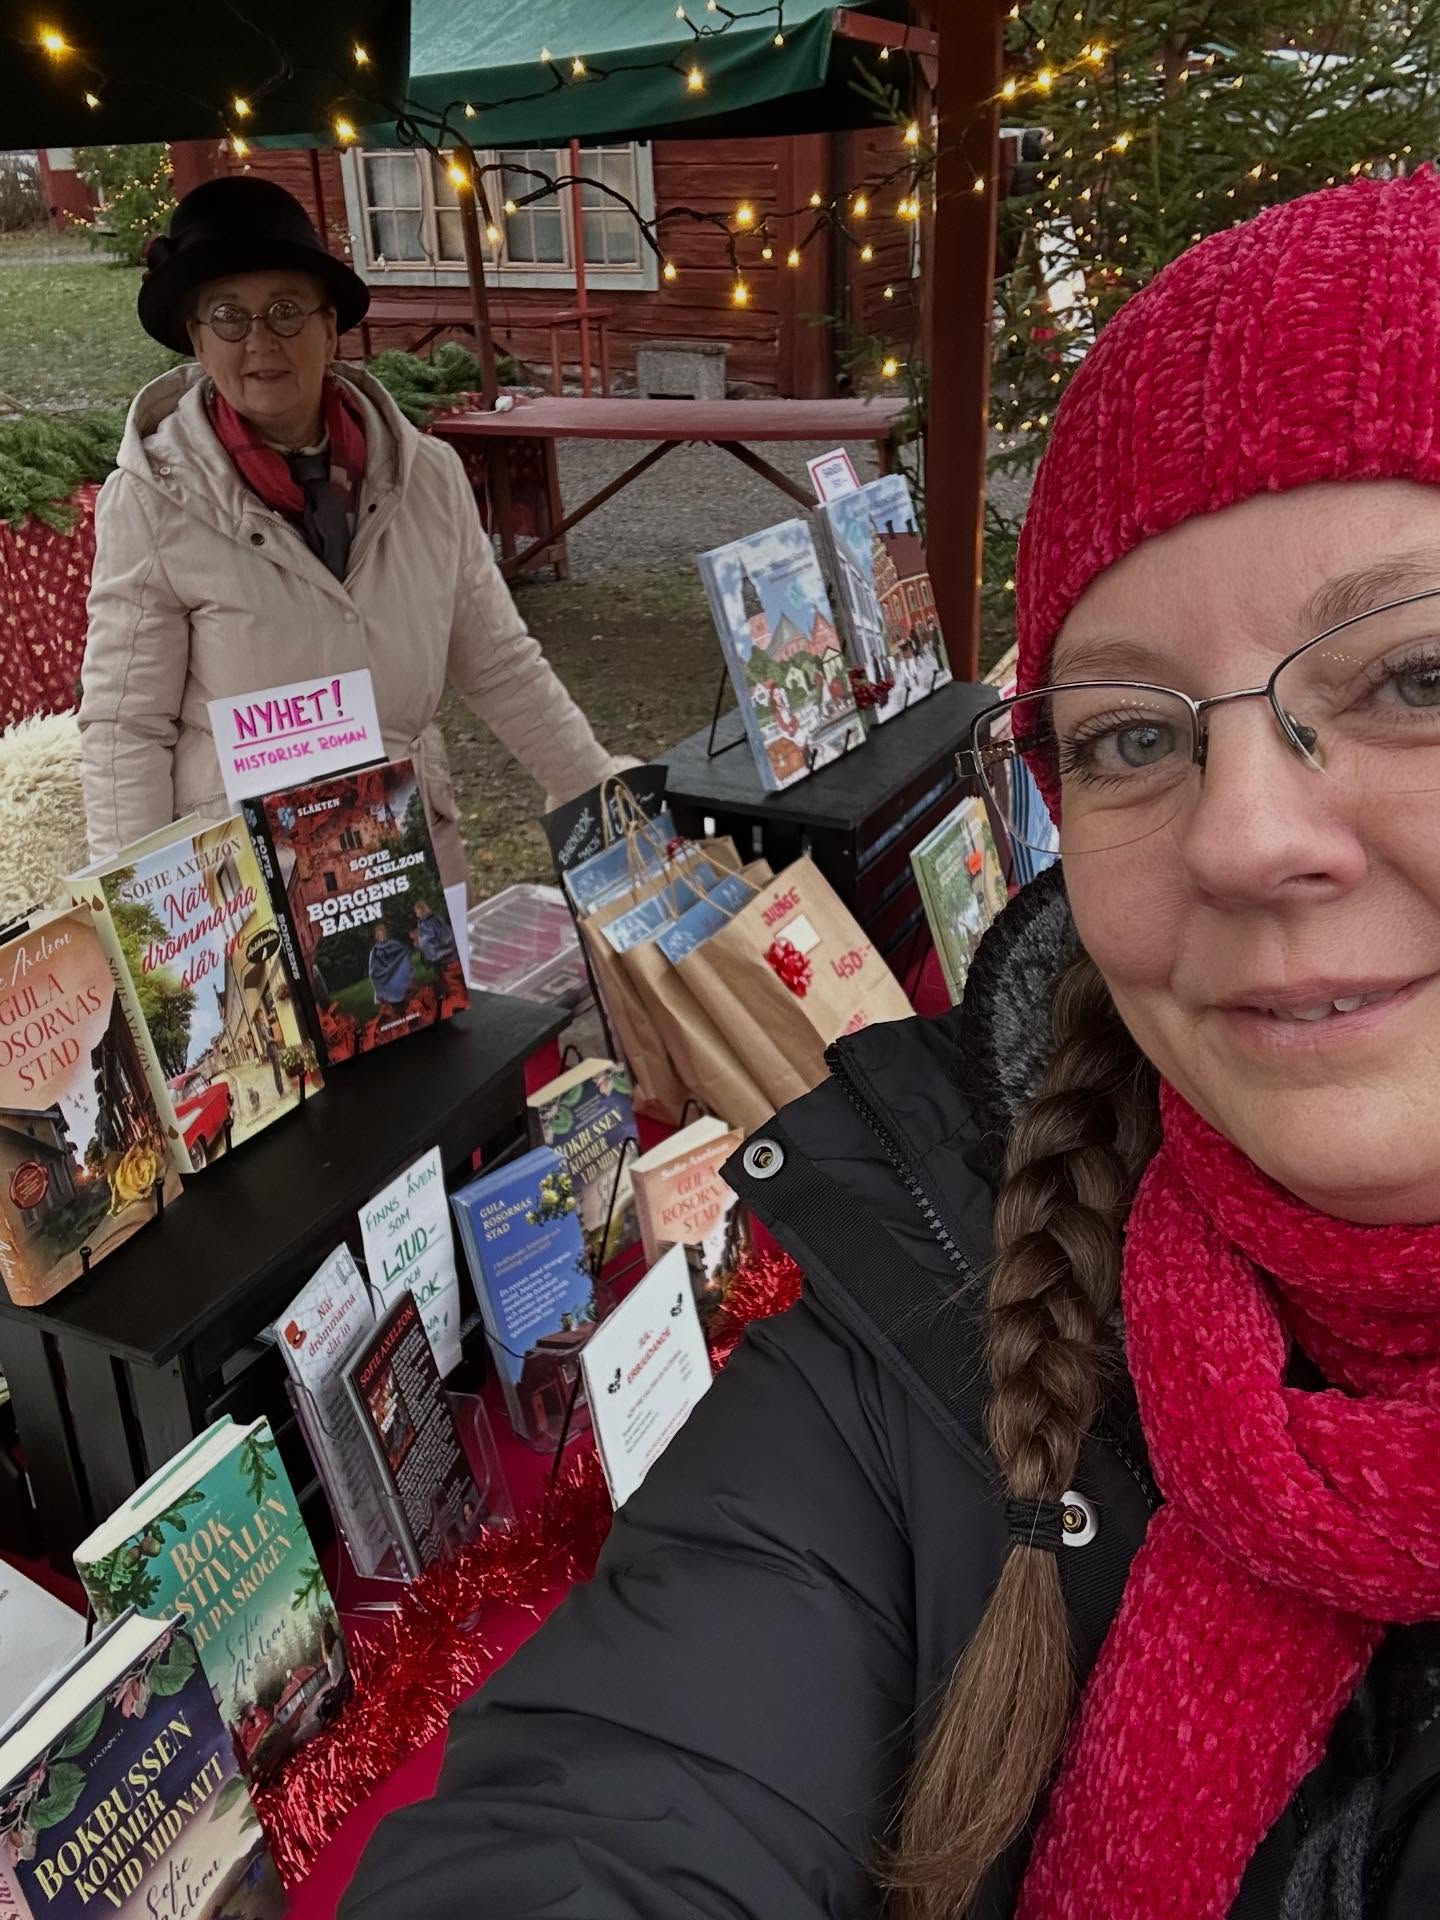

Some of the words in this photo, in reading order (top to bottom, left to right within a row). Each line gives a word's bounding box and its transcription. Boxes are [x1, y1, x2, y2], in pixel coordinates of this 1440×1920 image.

[233, 679, 344, 740] NYHET!
[234, 742, 313, 774] HISTORISK
[318, 726, 368, 750] ROMAN
[121, 870, 171, 904] SOFIE
[175, 837, 241, 882] AXELZON
[350, 849, 390, 872] SOFIE
[364, 851, 425, 880] AXELZON
[163, 880, 209, 929] När
[307, 875, 410, 922] BORGENS
[320, 901, 383, 937] BARN
[141, 886, 258, 976] drömmarna
[180, 949, 219, 991] slår
[223, 932, 247, 960] in
[0, 973, 65, 1027] GULA
[0, 985, 103, 1069] OSORNAS
[18, 1038, 80, 1092] STAD
[365, 1196, 400, 1233] FINNS
[387, 1207, 411, 1239] SOM
[479, 1199, 505, 1219] GULA
[482, 1197, 533, 1231] ROSORNAS
[485, 1222, 511, 1243] STAD
[382, 1224, 437, 1283] LJUD-
[360, 1354, 381, 1389] SOFIE
[170, 1508, 233, 1582] BOK
[33, 1710, 193, 1904] BOKBUSSEN
[103, 1857, 144, 1910] VID
[141, 1751, 226, 1869] MIDNATT
[73, 1789, 167, 1906] KOMMER
